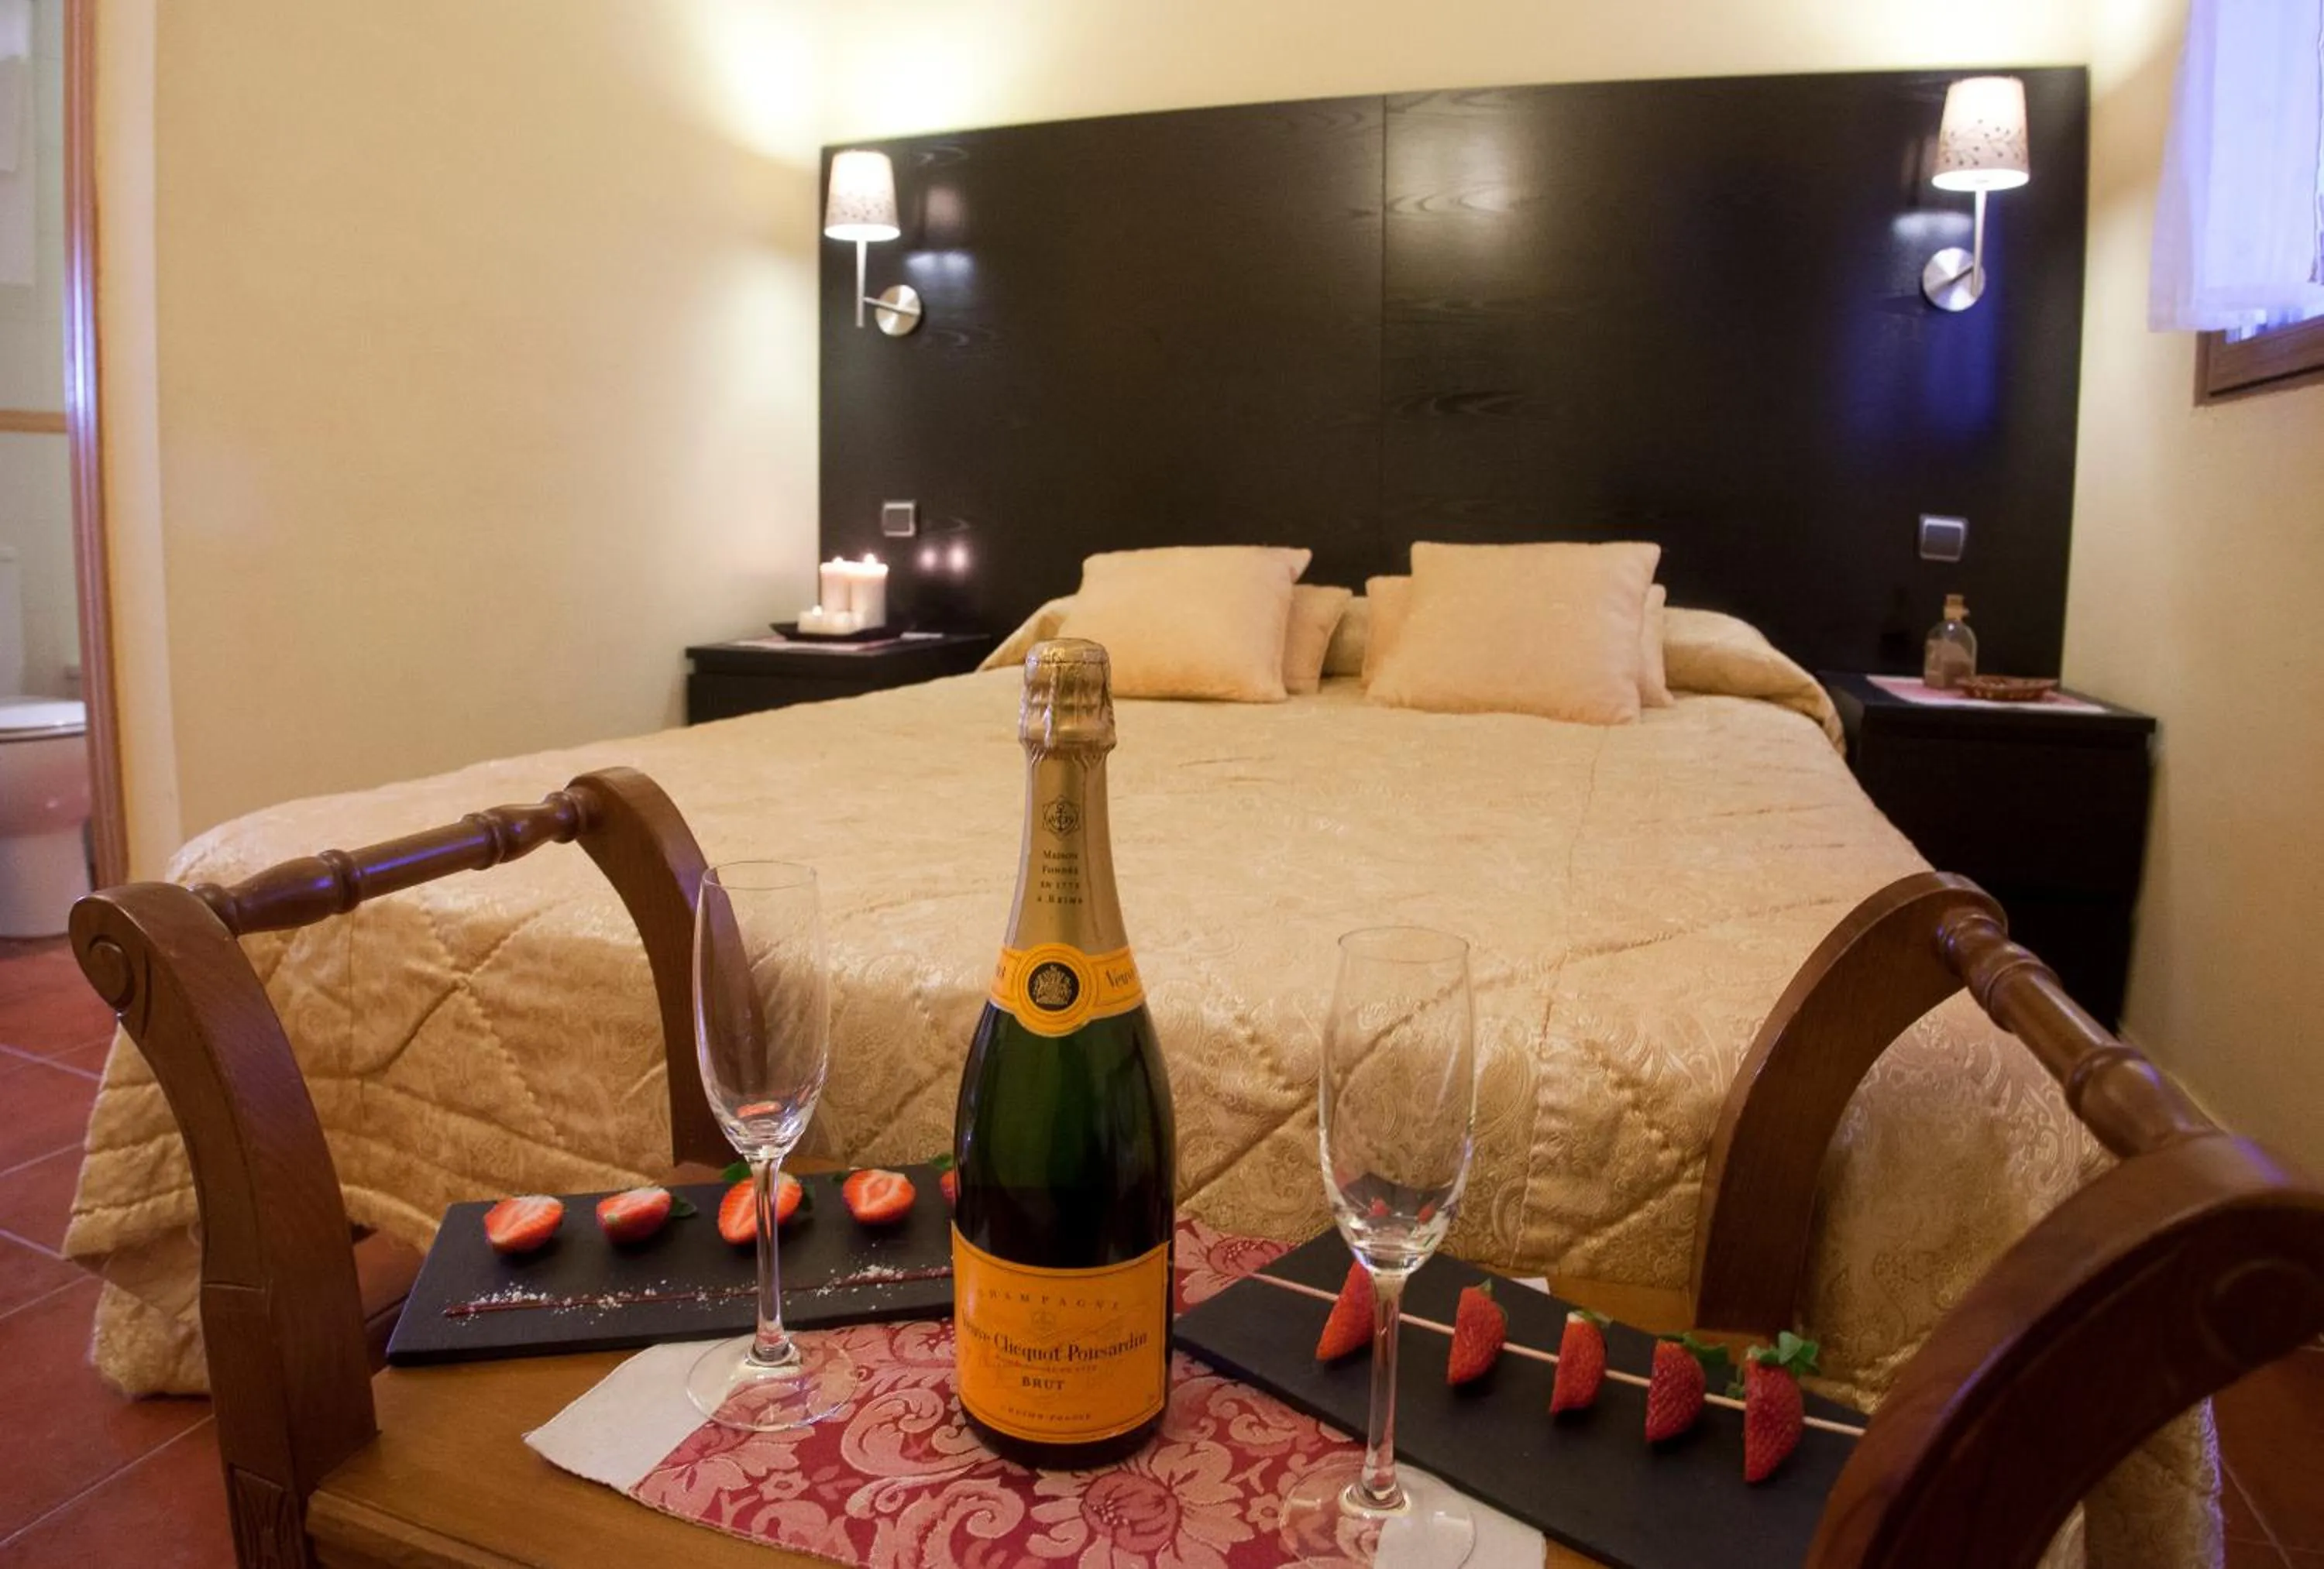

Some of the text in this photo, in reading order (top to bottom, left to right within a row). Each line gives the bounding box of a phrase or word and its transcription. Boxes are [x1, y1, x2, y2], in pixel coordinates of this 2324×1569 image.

[994, 1332, 1061, 1362] Clicquot
[1067, 1330, 1148, 1362] Ponsardin
[1022, 1375, 1065, 1390] BRUT
